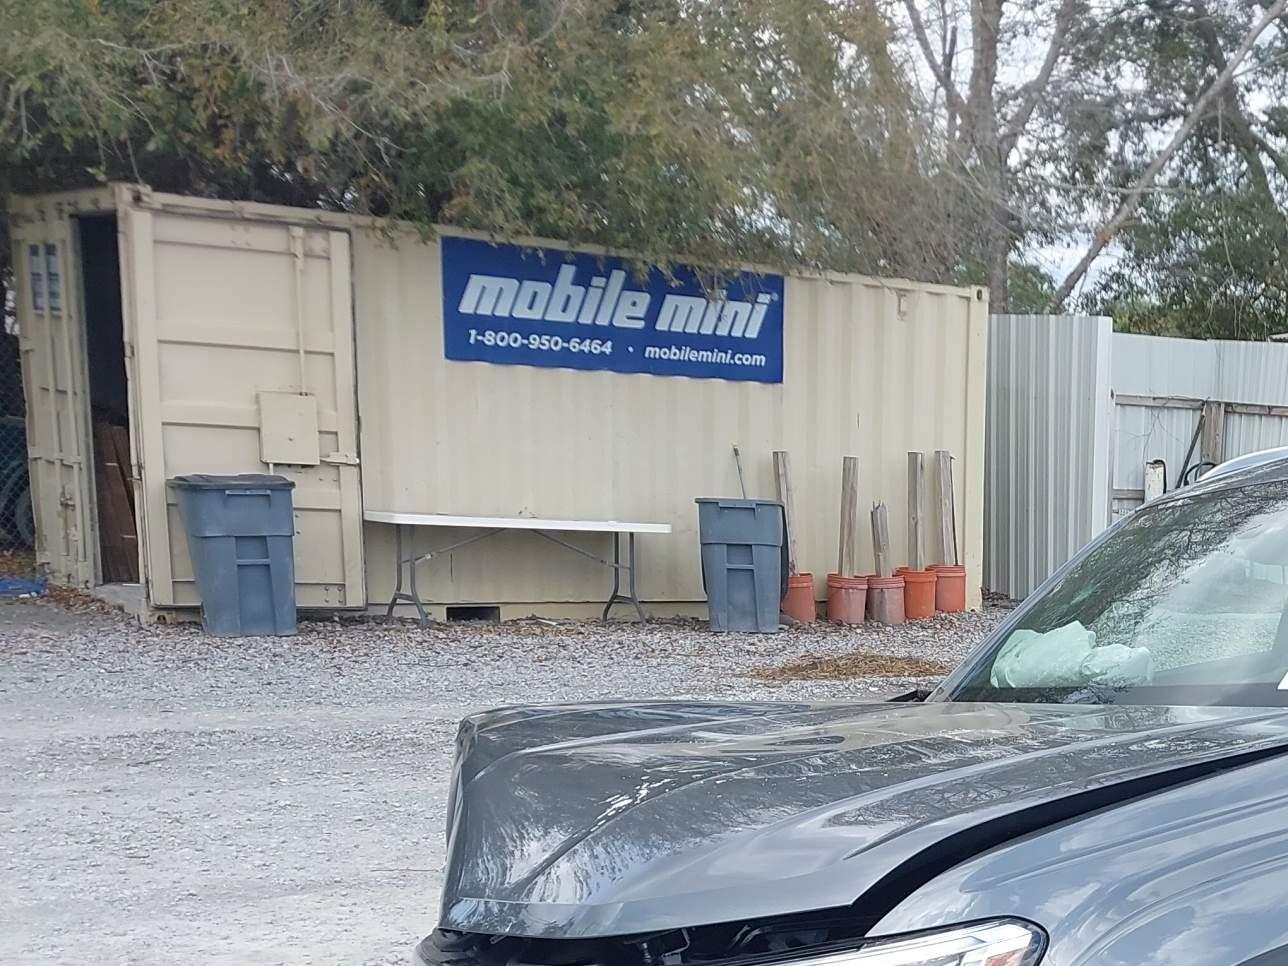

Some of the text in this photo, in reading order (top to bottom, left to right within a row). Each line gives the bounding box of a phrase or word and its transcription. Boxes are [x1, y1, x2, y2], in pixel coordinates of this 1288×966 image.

[458, 263, 772, 339] mobile mini
[468, 329, 766, 367] 1-800-950-6464 mobilemini.com
